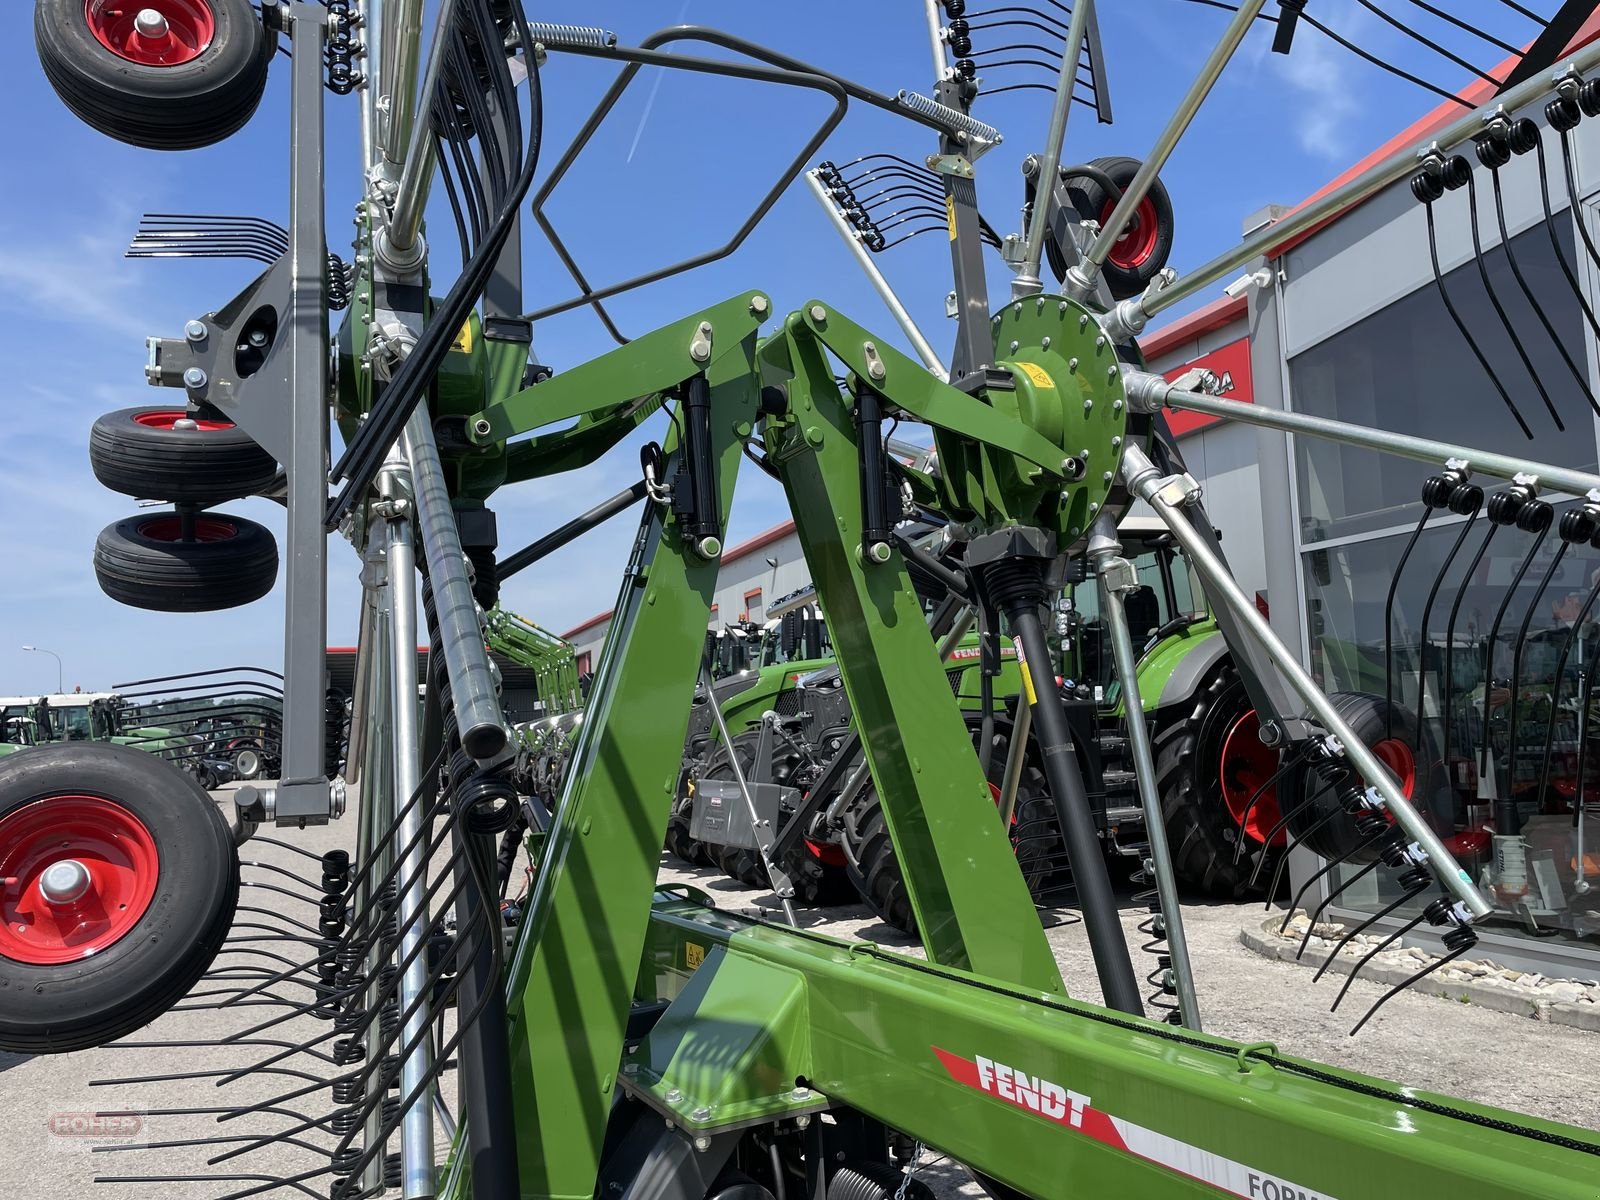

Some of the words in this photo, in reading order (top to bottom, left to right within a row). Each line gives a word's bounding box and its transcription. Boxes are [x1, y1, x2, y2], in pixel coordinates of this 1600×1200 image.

[954, 648, 981, 659] FEND
[1498, 849, 1506, 873] STIHL
[975, 1054, 1091, 1128] FENDT
